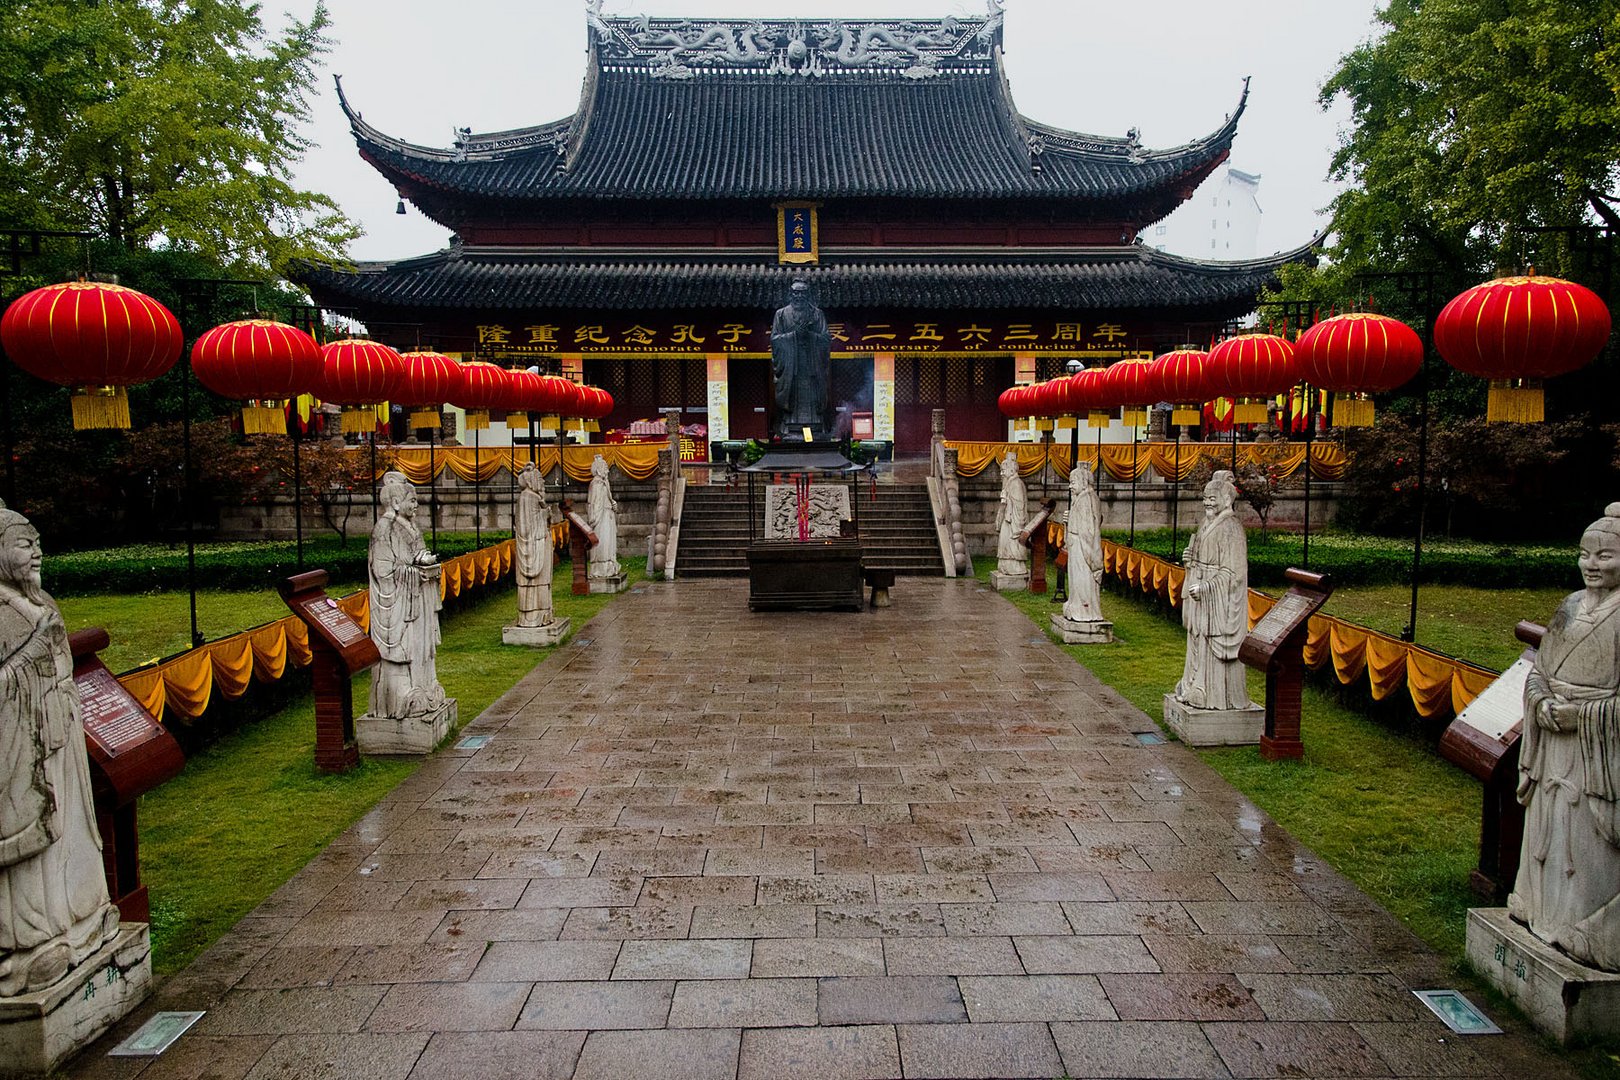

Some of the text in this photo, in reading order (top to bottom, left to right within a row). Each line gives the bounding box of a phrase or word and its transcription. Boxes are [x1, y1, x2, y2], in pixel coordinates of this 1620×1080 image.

[792, 211, 804, 249] 大成殿
[476, 323, 1128, 344] 隆重纪念孔子辰二五六三周年
[580, 344, 701, 352] commemorate
[723, 344, 747, 352] the
[845, 343, 940, 353] anniversary
[964, 342, 983, 350] of
[998, 342, 1076, 351] confucius
